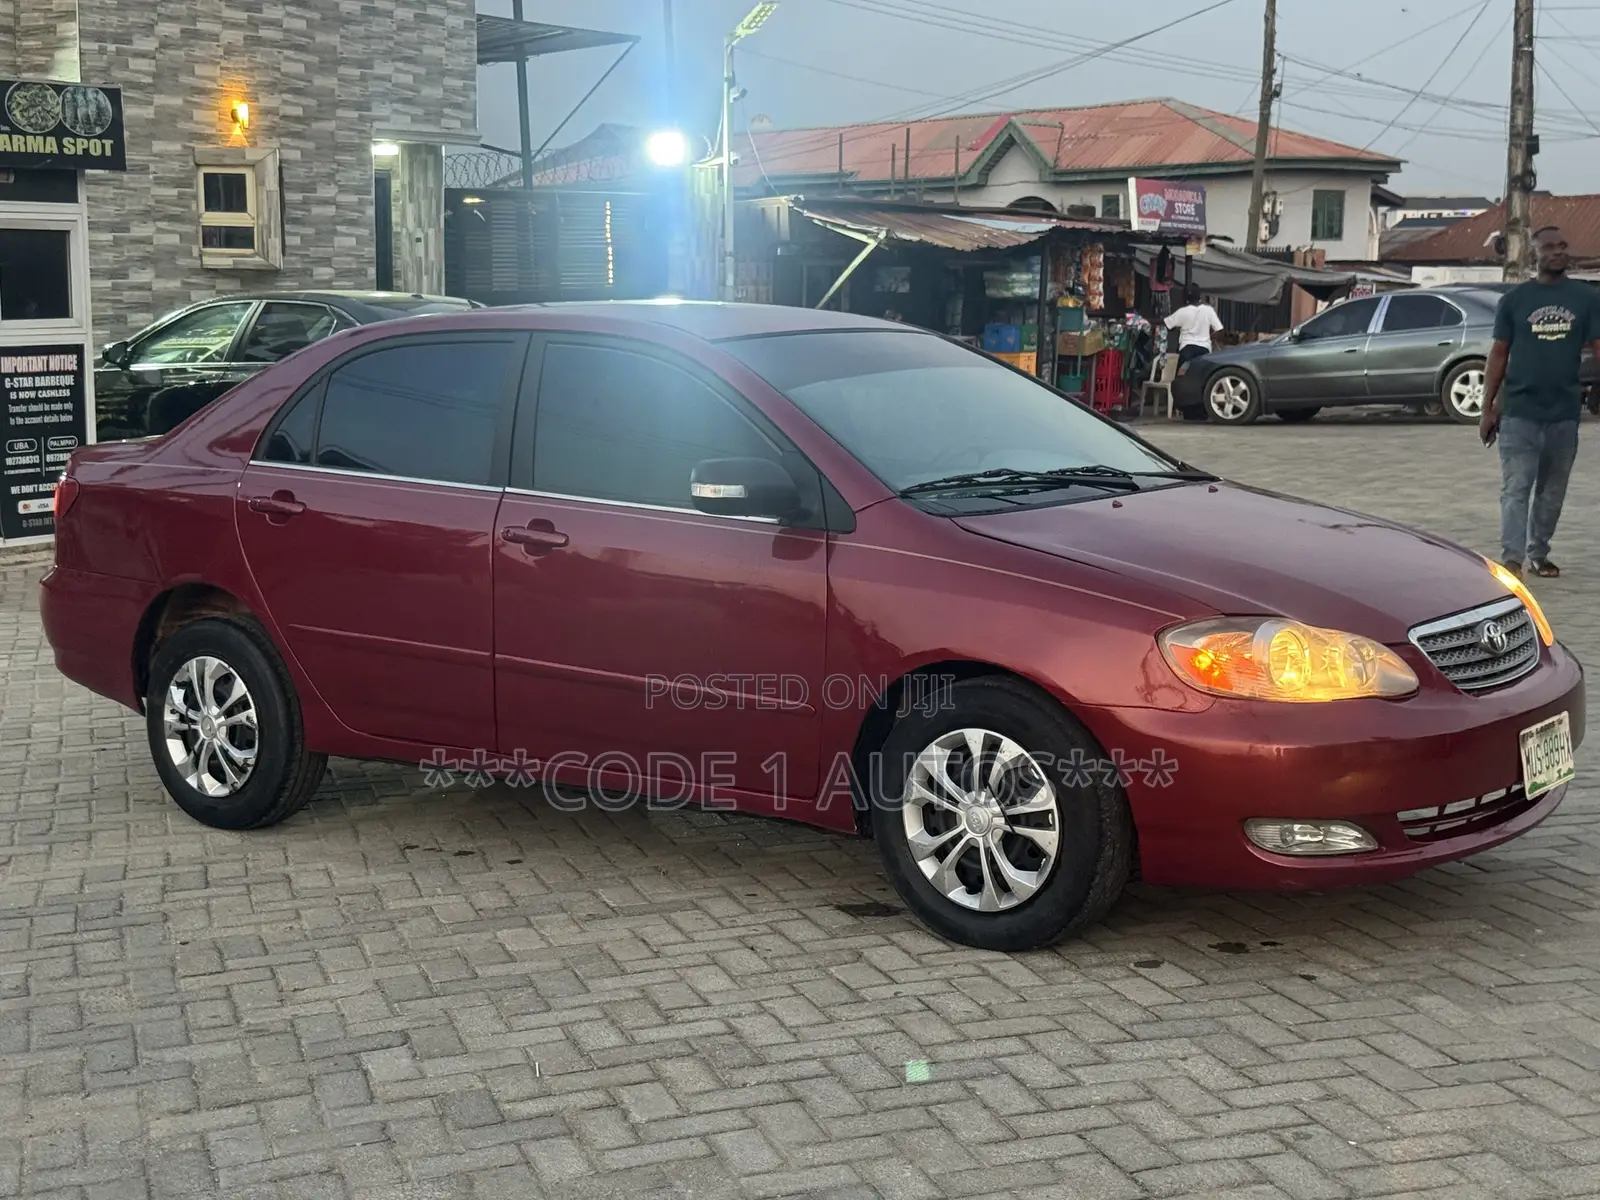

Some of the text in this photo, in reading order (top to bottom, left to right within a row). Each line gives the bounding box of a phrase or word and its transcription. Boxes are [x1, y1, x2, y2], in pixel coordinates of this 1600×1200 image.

[62, 136, 114, 156] SPOT
[1174, 202, 1196, 215] STORE
[1, 355, 77, 373] IMPORTANT NOTICE
[5, 375, 74, 388] G-STAR BARBEQUE
[10, 389, 70, 399] IS NOW CASHLESS
[8, 401, 73, 413] Transfer should be made only
[10, 413, 73, 425] to the account details below
[14, 442, 29, 450] UBA
[11, 482, 58, 494] WE DON'T ACCEP
